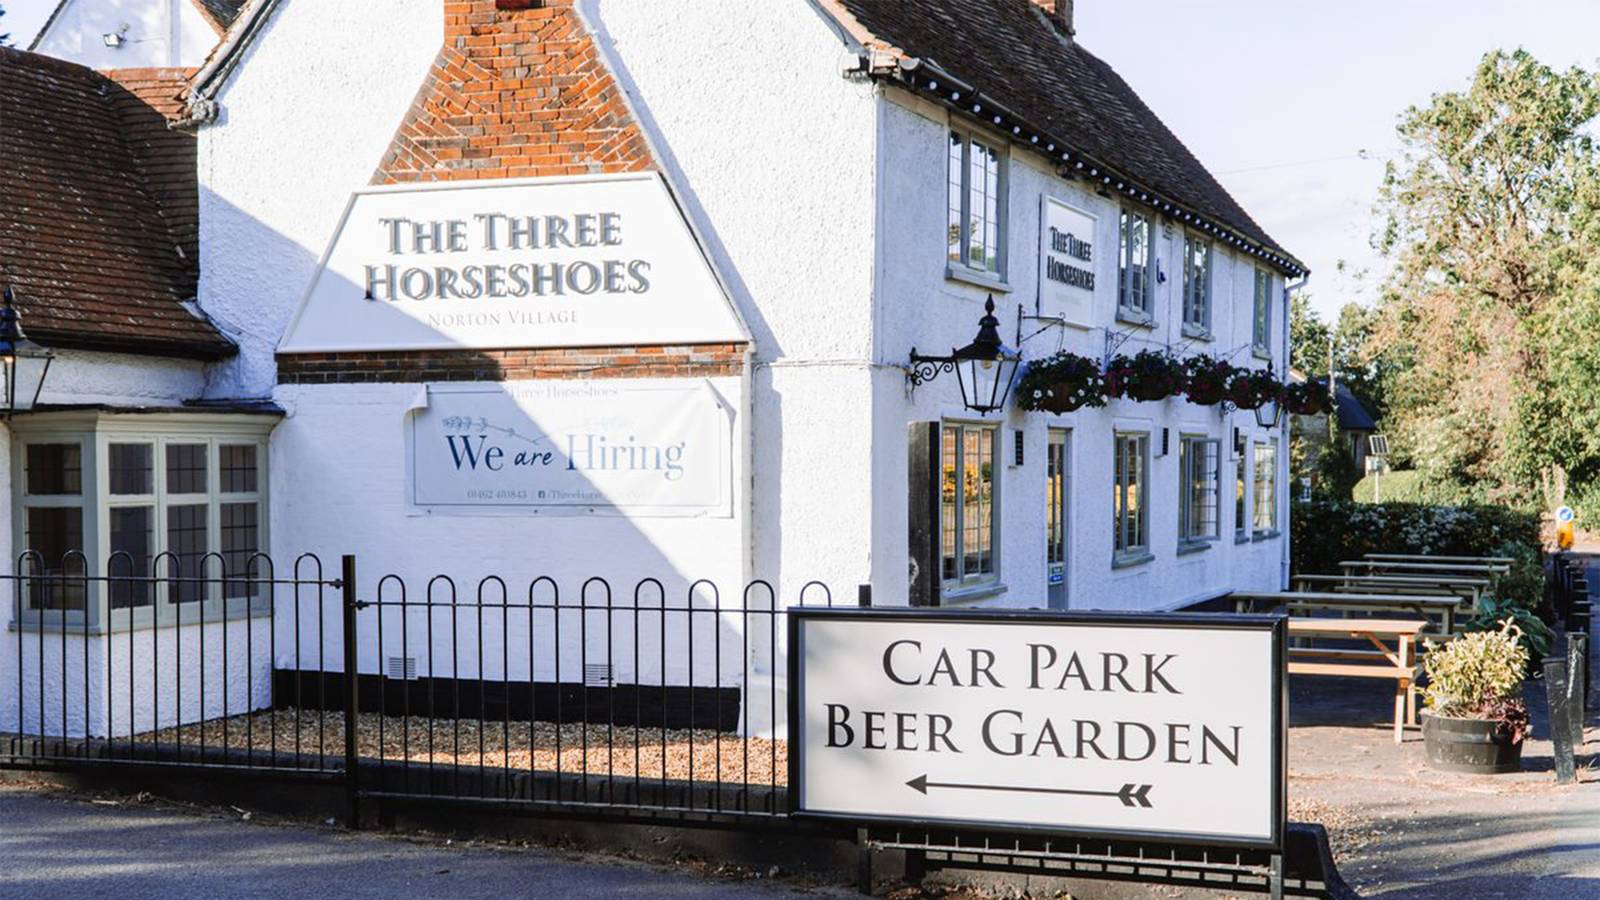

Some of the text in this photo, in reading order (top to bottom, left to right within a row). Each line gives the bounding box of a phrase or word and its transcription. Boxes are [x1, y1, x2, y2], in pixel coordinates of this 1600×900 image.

[379, 211, 622, 255] THE THREE
[1049, 226, 1092, 262] THE THREE
[363, 259, 652, 302] HORSESHOES
[1047, 255, 1096, 292] HORSESHOES
[427, 310, 577, 328] NORTON VILLAGE
[445, 433, 686, 482] We are Hiring
[882, 639, 1183, 695] CAR PARK
[823, 703, 1244, 767] BEER GARDEN
